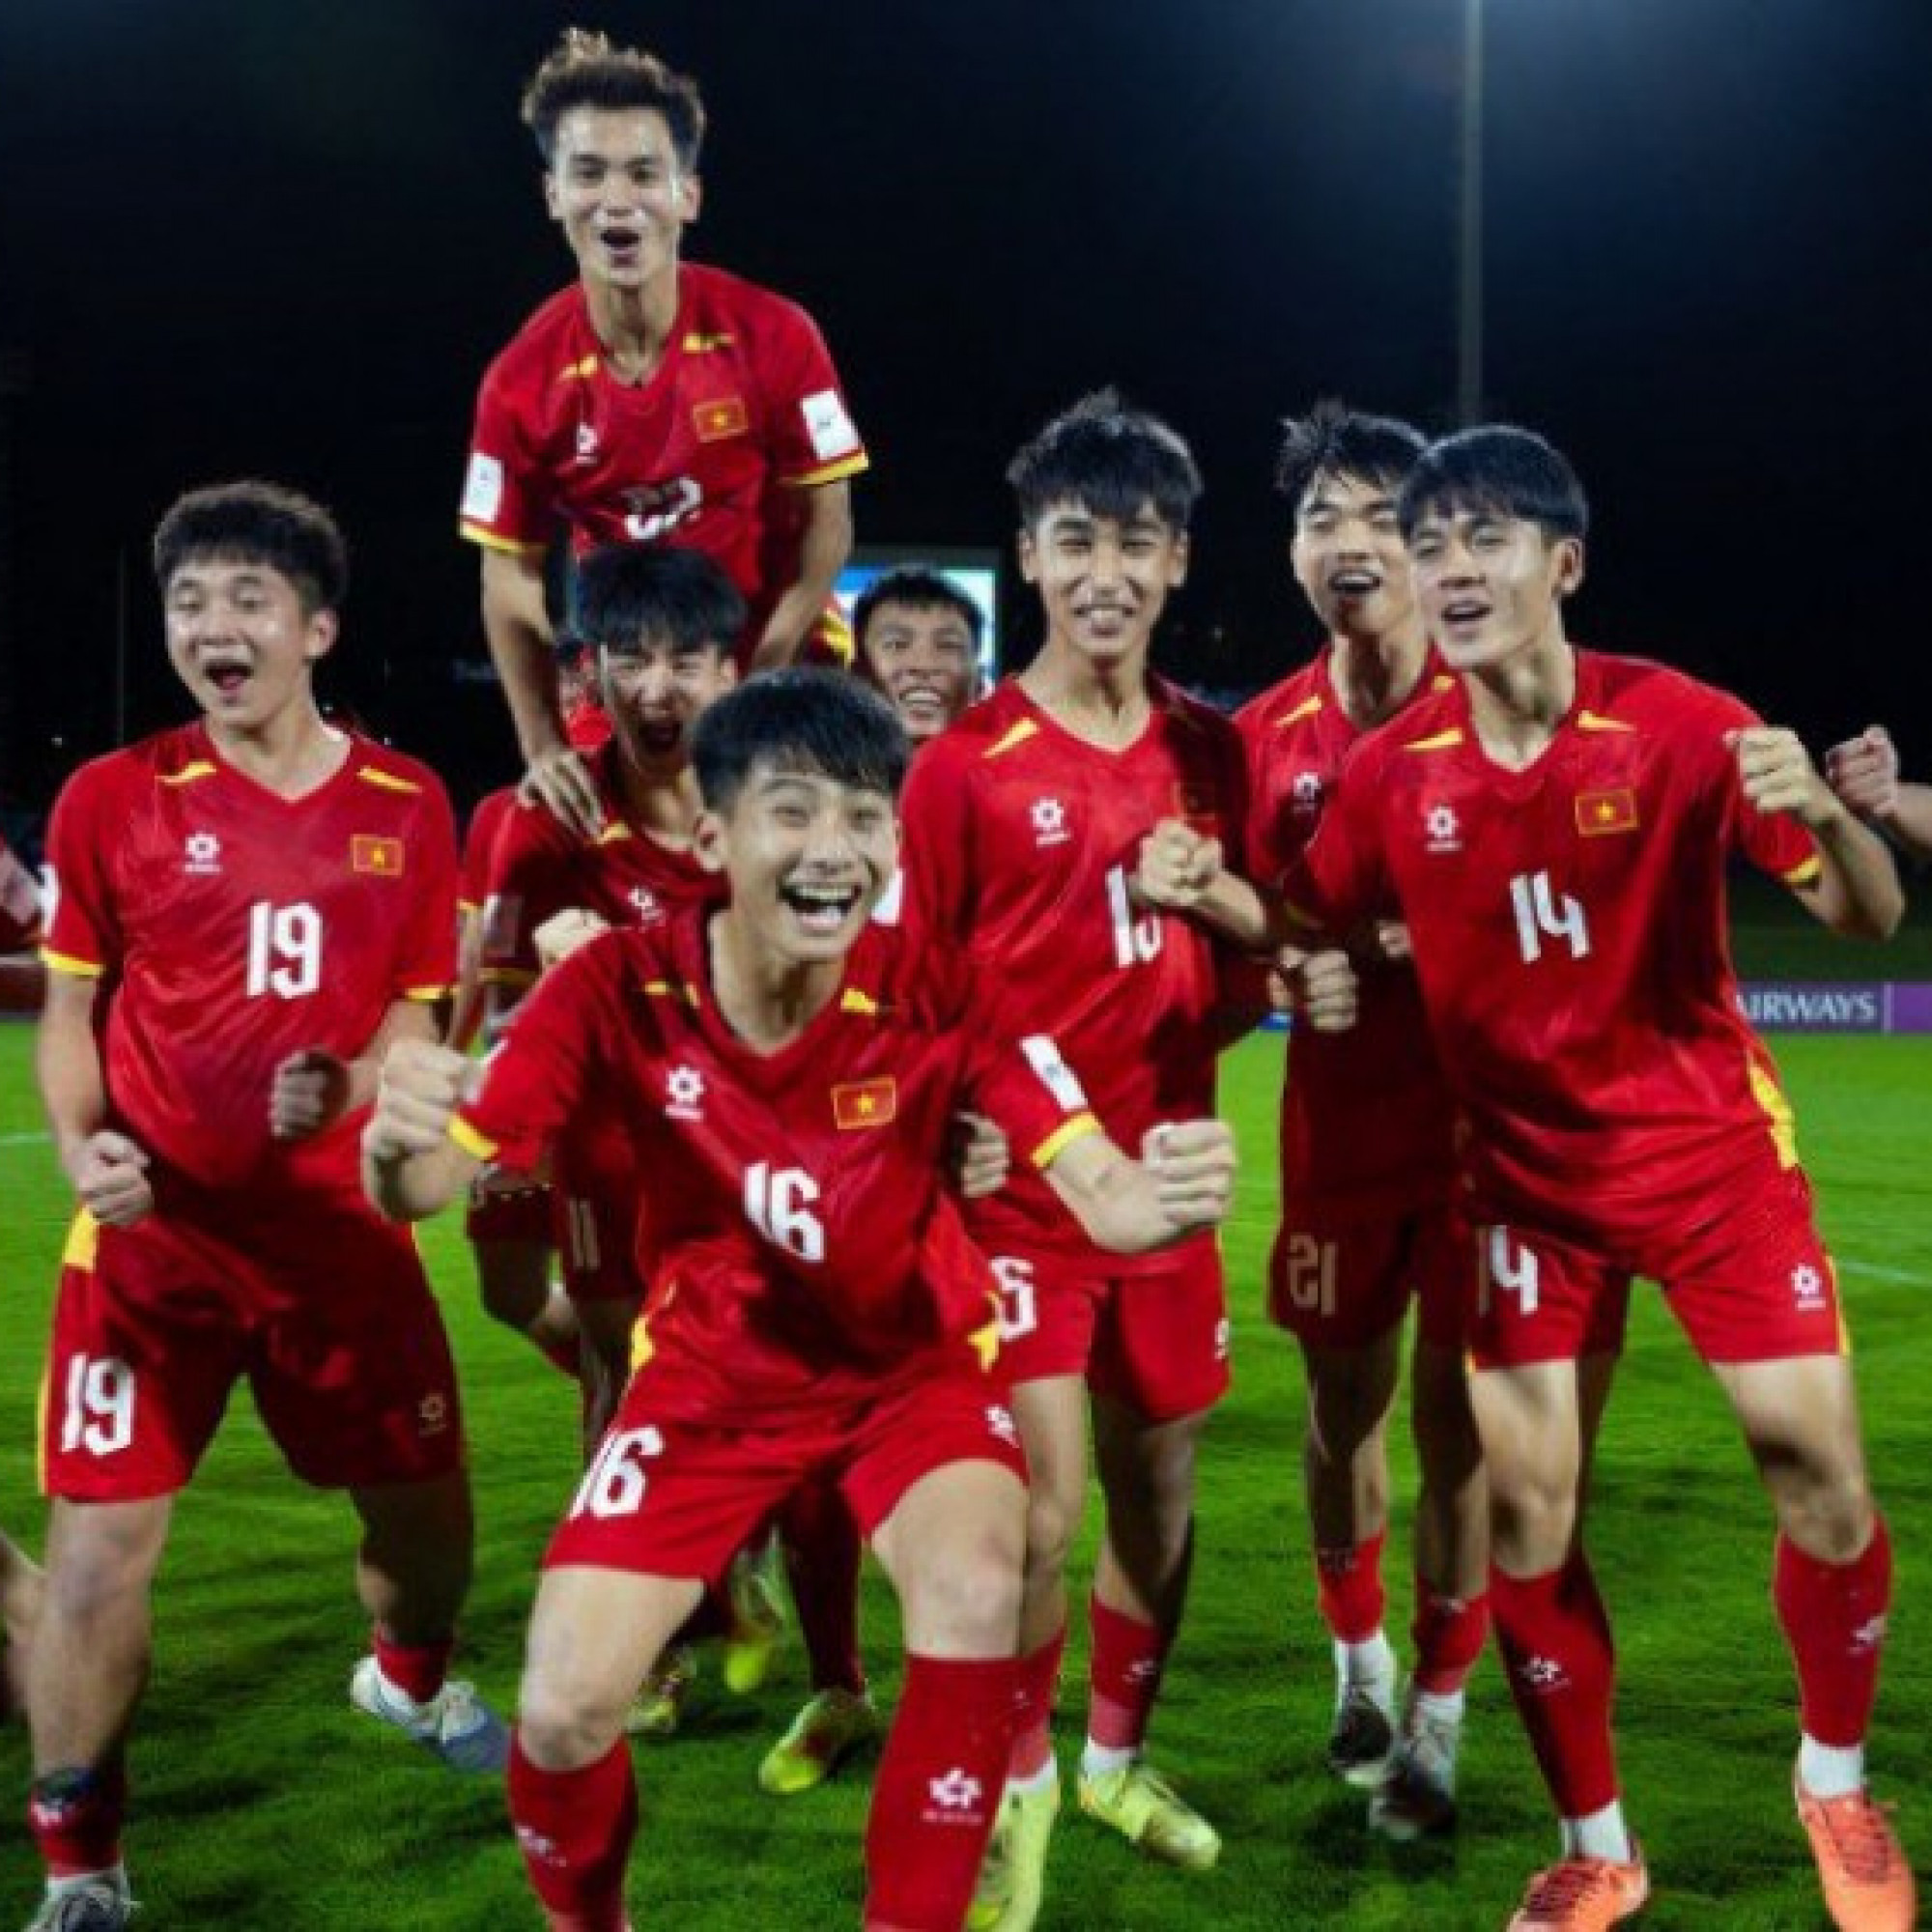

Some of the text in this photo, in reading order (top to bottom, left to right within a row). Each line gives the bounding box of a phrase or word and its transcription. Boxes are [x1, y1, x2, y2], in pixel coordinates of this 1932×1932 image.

[247, 900, 323, 999] 19
[1510, 870, 1589, 963] 14
[743, 1161, 825, 1262] 16
[1288, 1234, 1338, 1316] 21
[1475, 1224, 1538, 1317] 14
[61, 1352, 136, 1456] 19
[569, 1425, 664, 1520] 16
